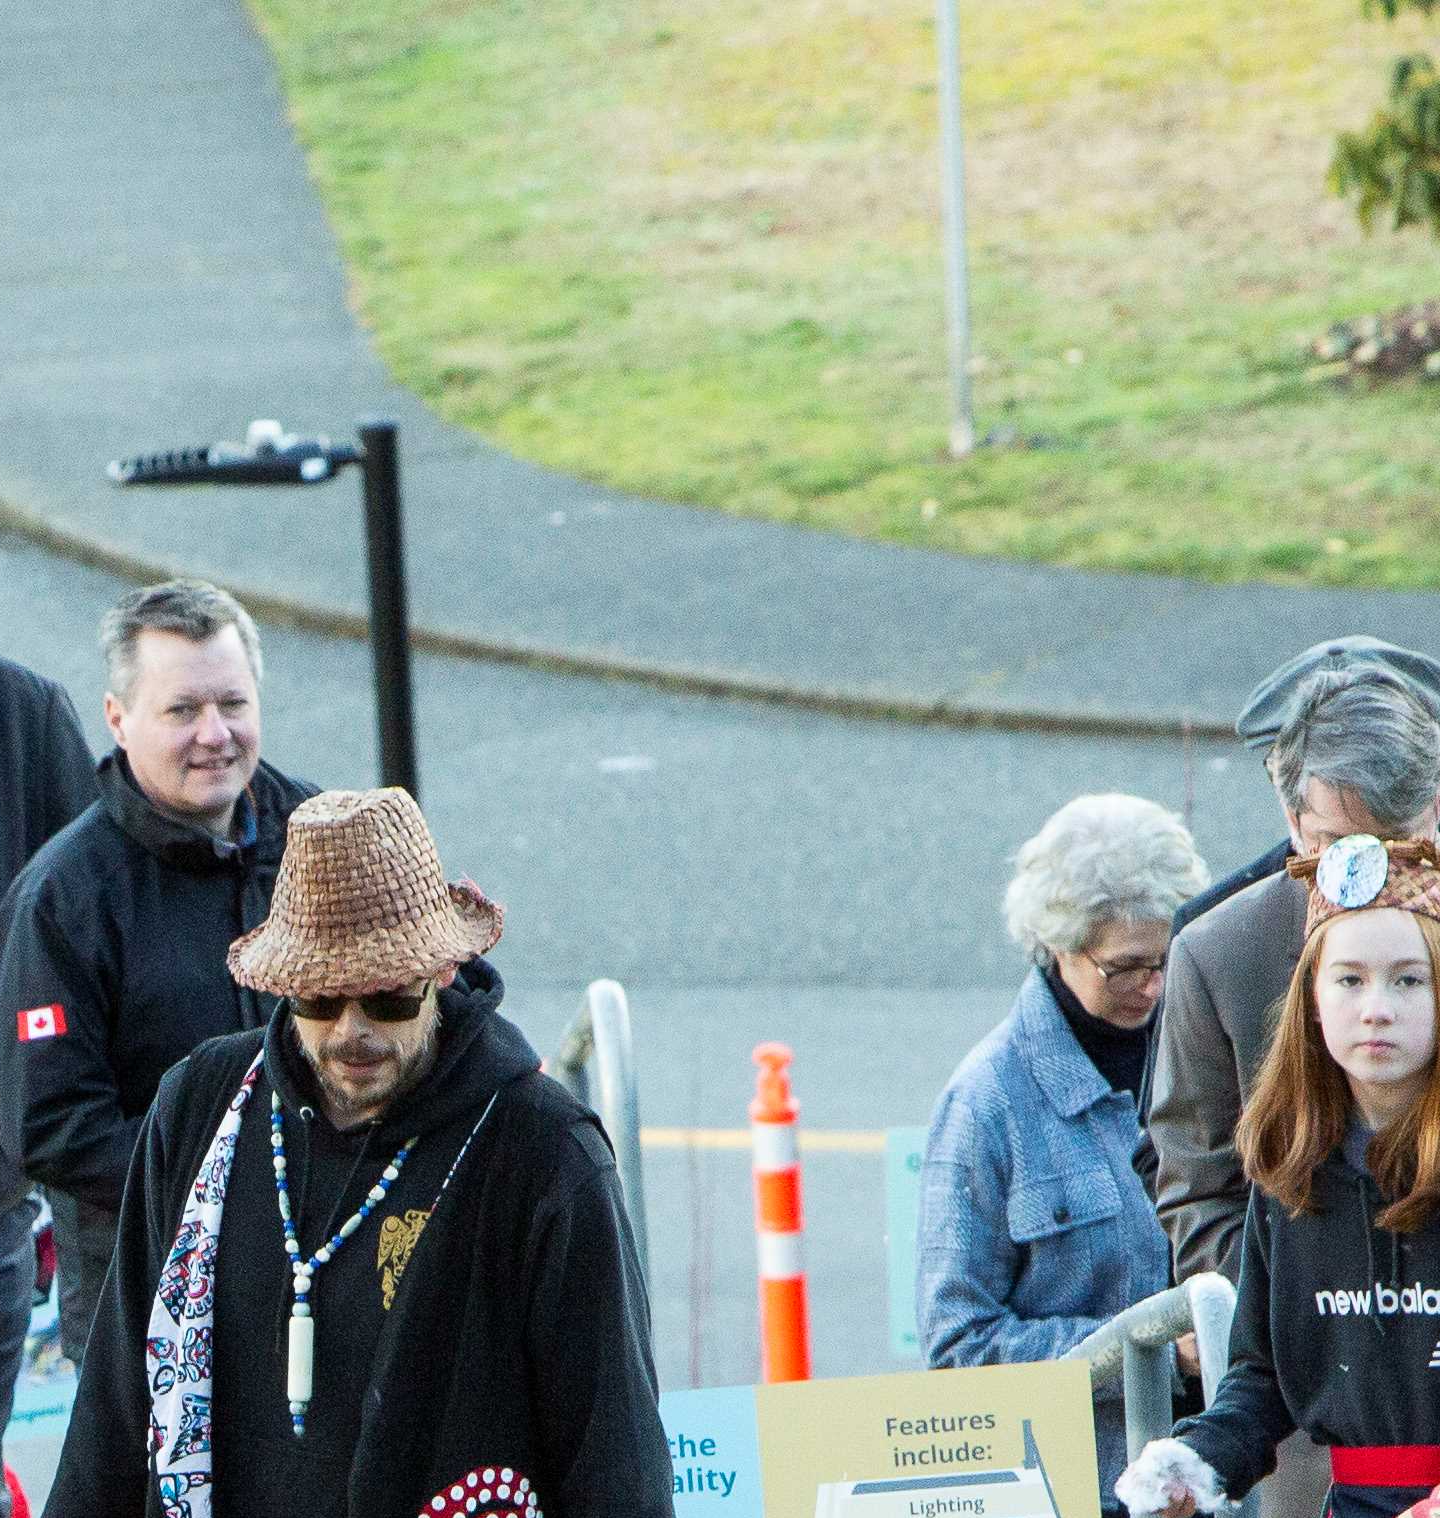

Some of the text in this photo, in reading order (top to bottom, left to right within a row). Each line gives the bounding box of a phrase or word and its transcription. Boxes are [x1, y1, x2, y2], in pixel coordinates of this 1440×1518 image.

[1315, 1288, 1371, 1316] new
[886, 1413, 996, 1437] Features
[669, 1434, 716, 1458] the
[894, 1441, 993, 1467] include:
[909, 1496, 985, 1518] Lighting
